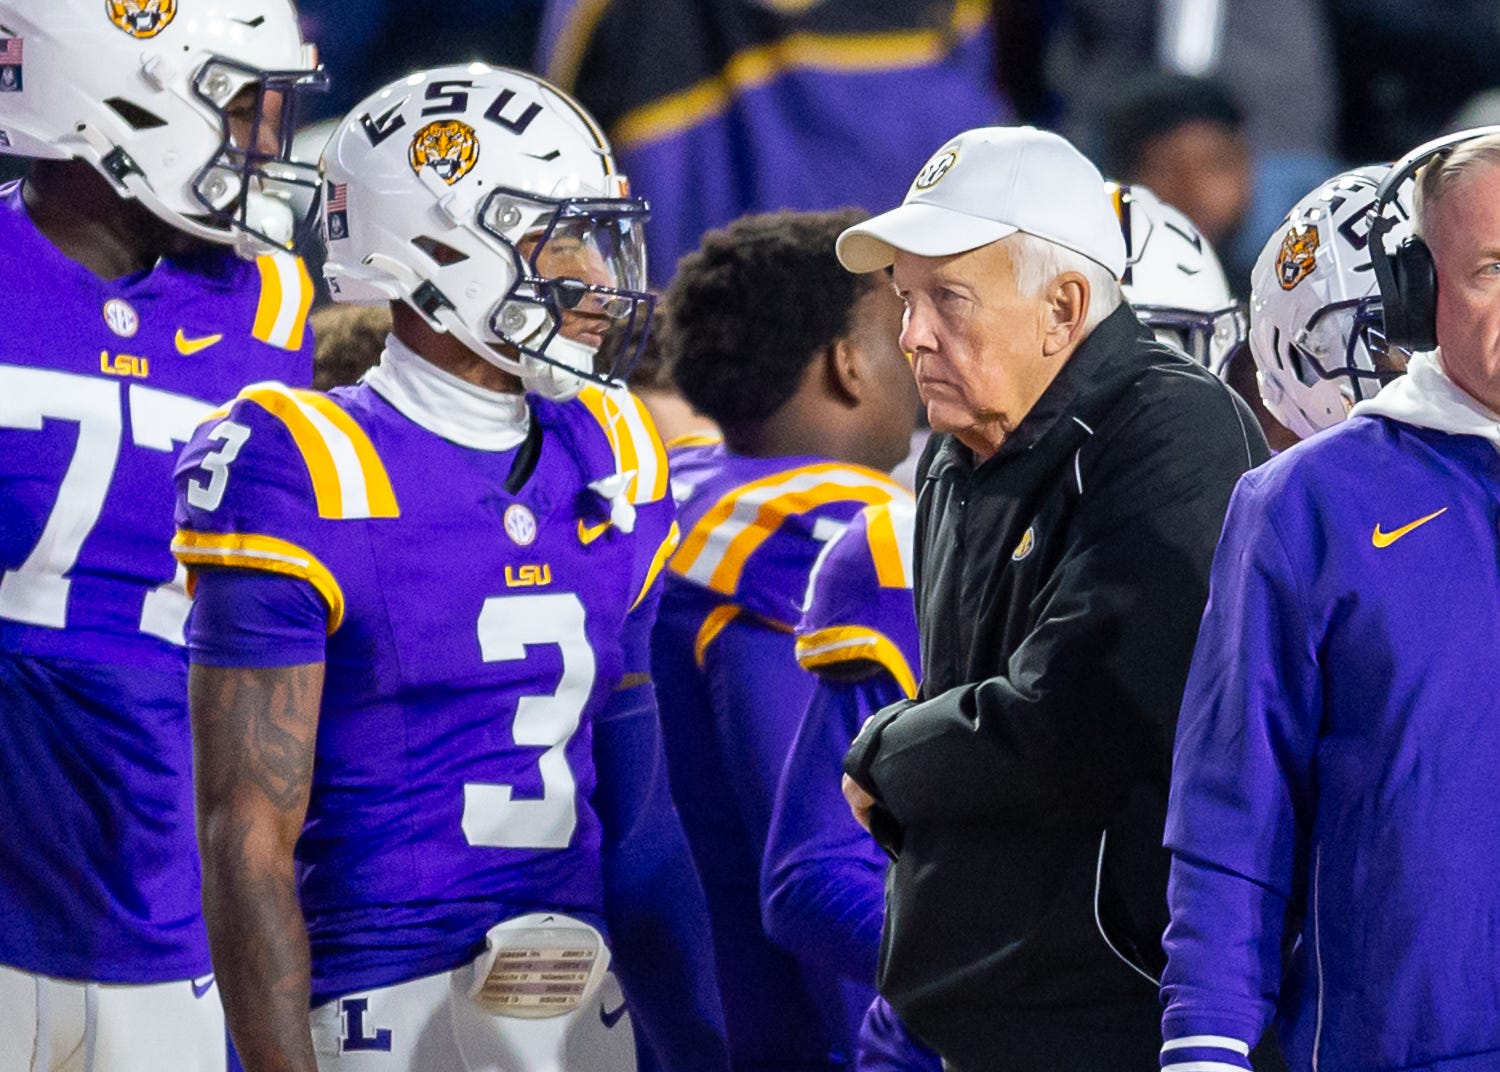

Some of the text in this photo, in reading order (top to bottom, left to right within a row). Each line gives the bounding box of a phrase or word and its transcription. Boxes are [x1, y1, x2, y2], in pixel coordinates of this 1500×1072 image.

[359, 80, 543, 147] LSU
[100, 350, 149, 378] LSU
[187, 420, 252, 512] 3
[504, 563, 552, 588] LSU
[461, 592, 597, 849] 3
[341, 997, 392, 1052] L
